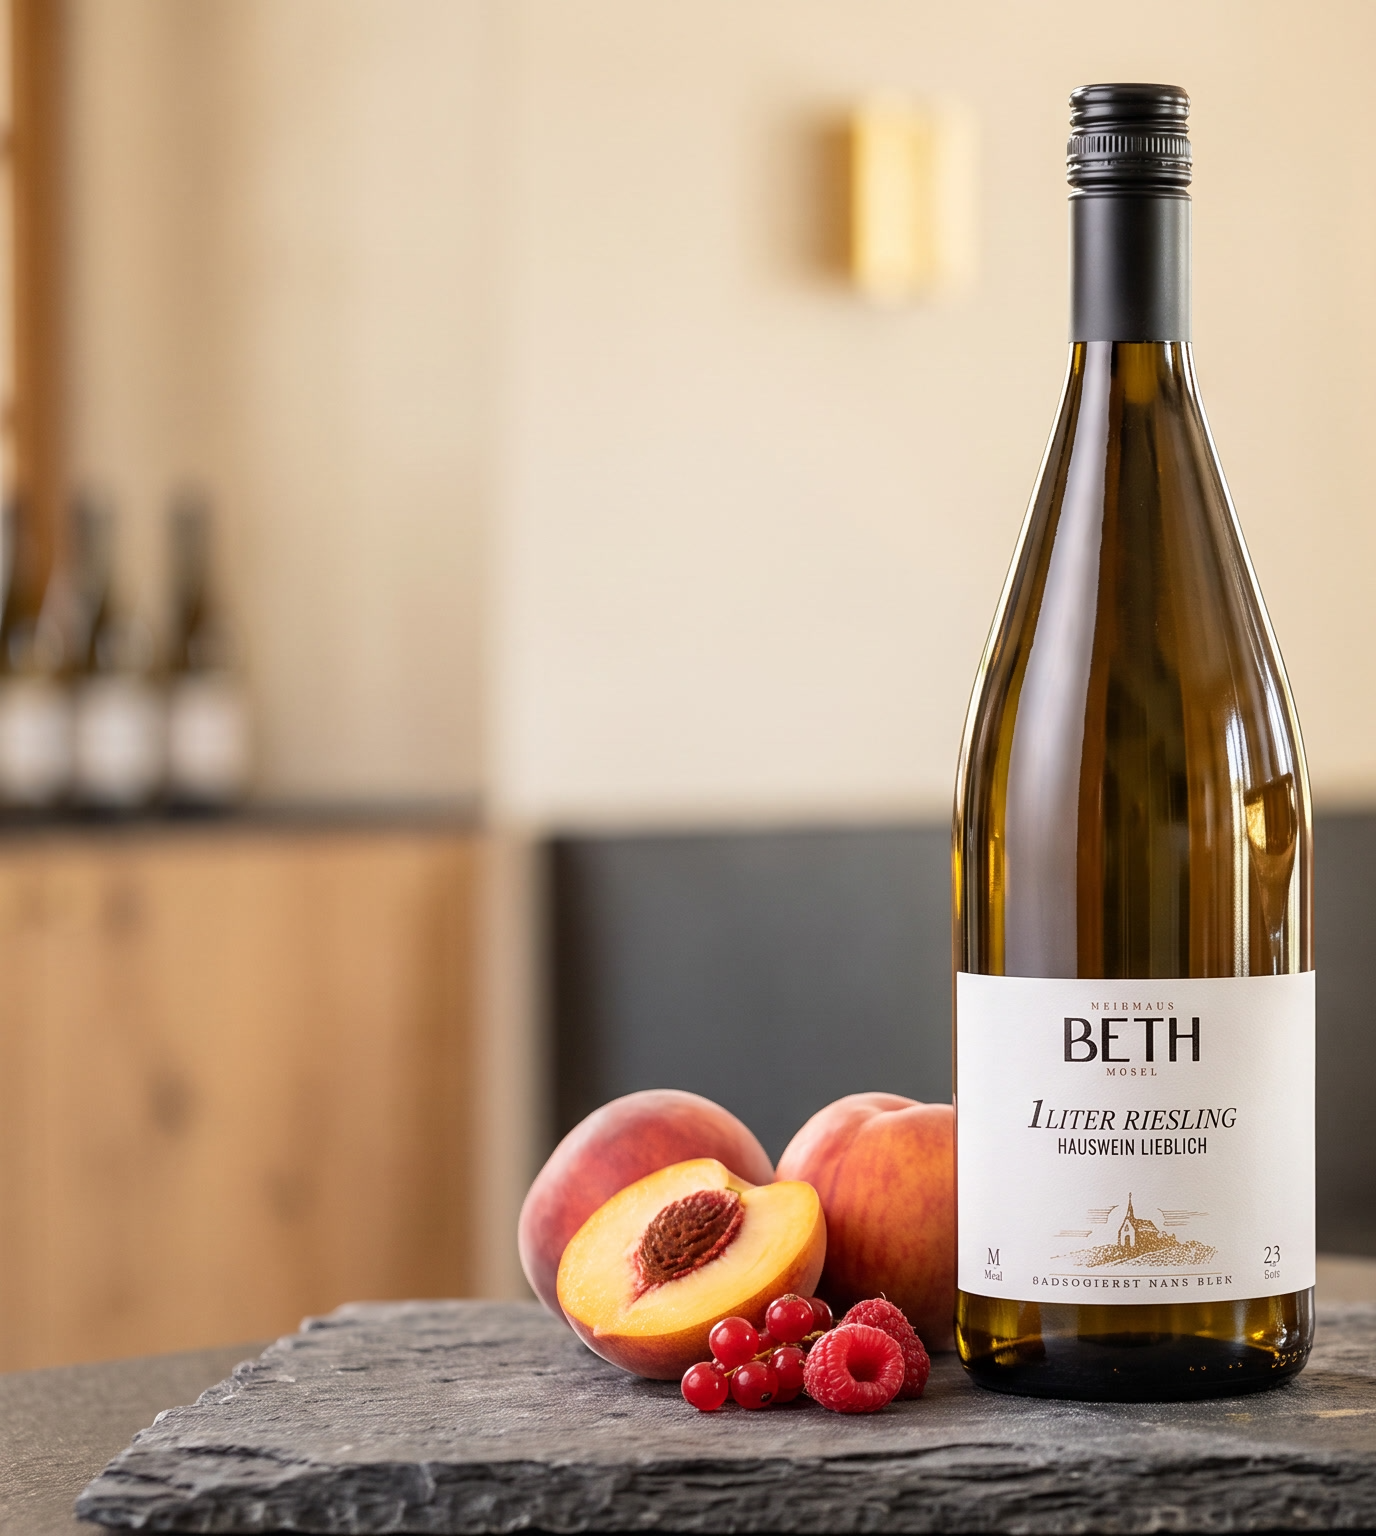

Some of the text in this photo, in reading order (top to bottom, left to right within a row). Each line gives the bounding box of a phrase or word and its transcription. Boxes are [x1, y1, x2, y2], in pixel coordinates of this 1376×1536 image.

[1063, 1016, 1200, 1063] BETH
[1106, 1067, 1157, 1077] MOSEL
[1122, 1107, 1237, 1131] RIESLING
[1058, 1137, 1207, 1156] HAUSWEIN LIEBLICH
[987, 1247, 1001, 1266] M
[1263, 1245, 1281, 1264] 23
[1149, 1278, 1189, 1288] NANS
